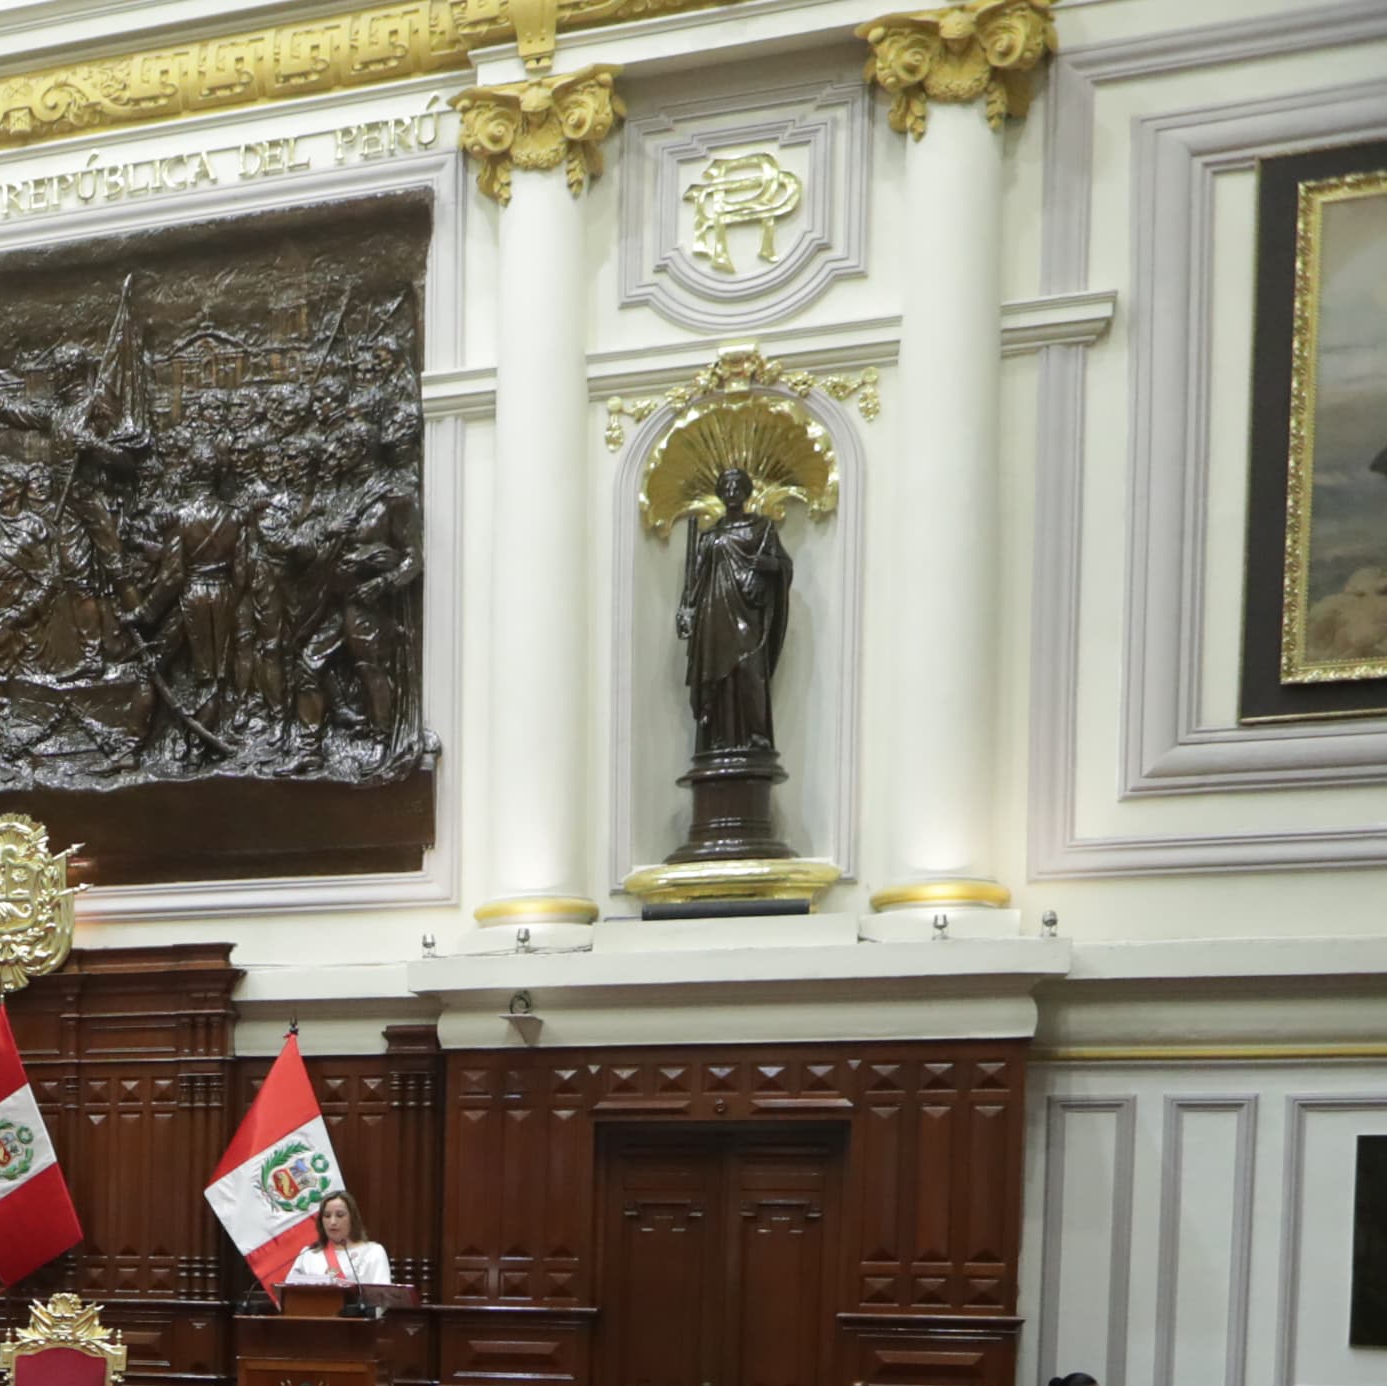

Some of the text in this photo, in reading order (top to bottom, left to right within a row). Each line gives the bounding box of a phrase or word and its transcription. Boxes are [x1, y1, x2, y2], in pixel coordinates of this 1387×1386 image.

[0, 148, 219, 219] REPÚBLICA
[238, 136, 311, 178] DEL
[335, 91, 441, 164] PERÚ
